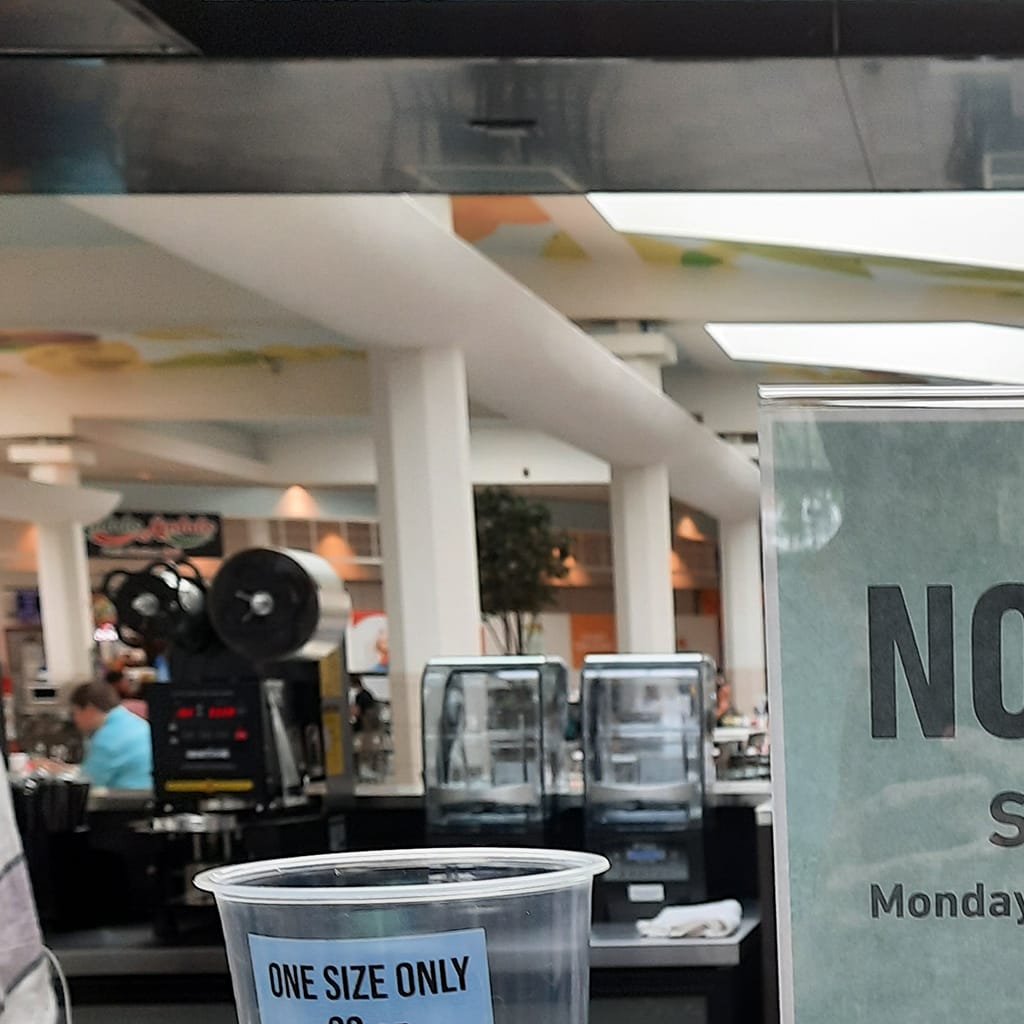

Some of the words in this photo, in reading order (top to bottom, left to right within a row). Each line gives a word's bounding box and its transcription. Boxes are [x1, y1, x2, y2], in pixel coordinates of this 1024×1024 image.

[268, 961, 316, 1001] ONE
[325, 963, 386, 1001] SIZE
[396, 956, 471, 998] ONLY
